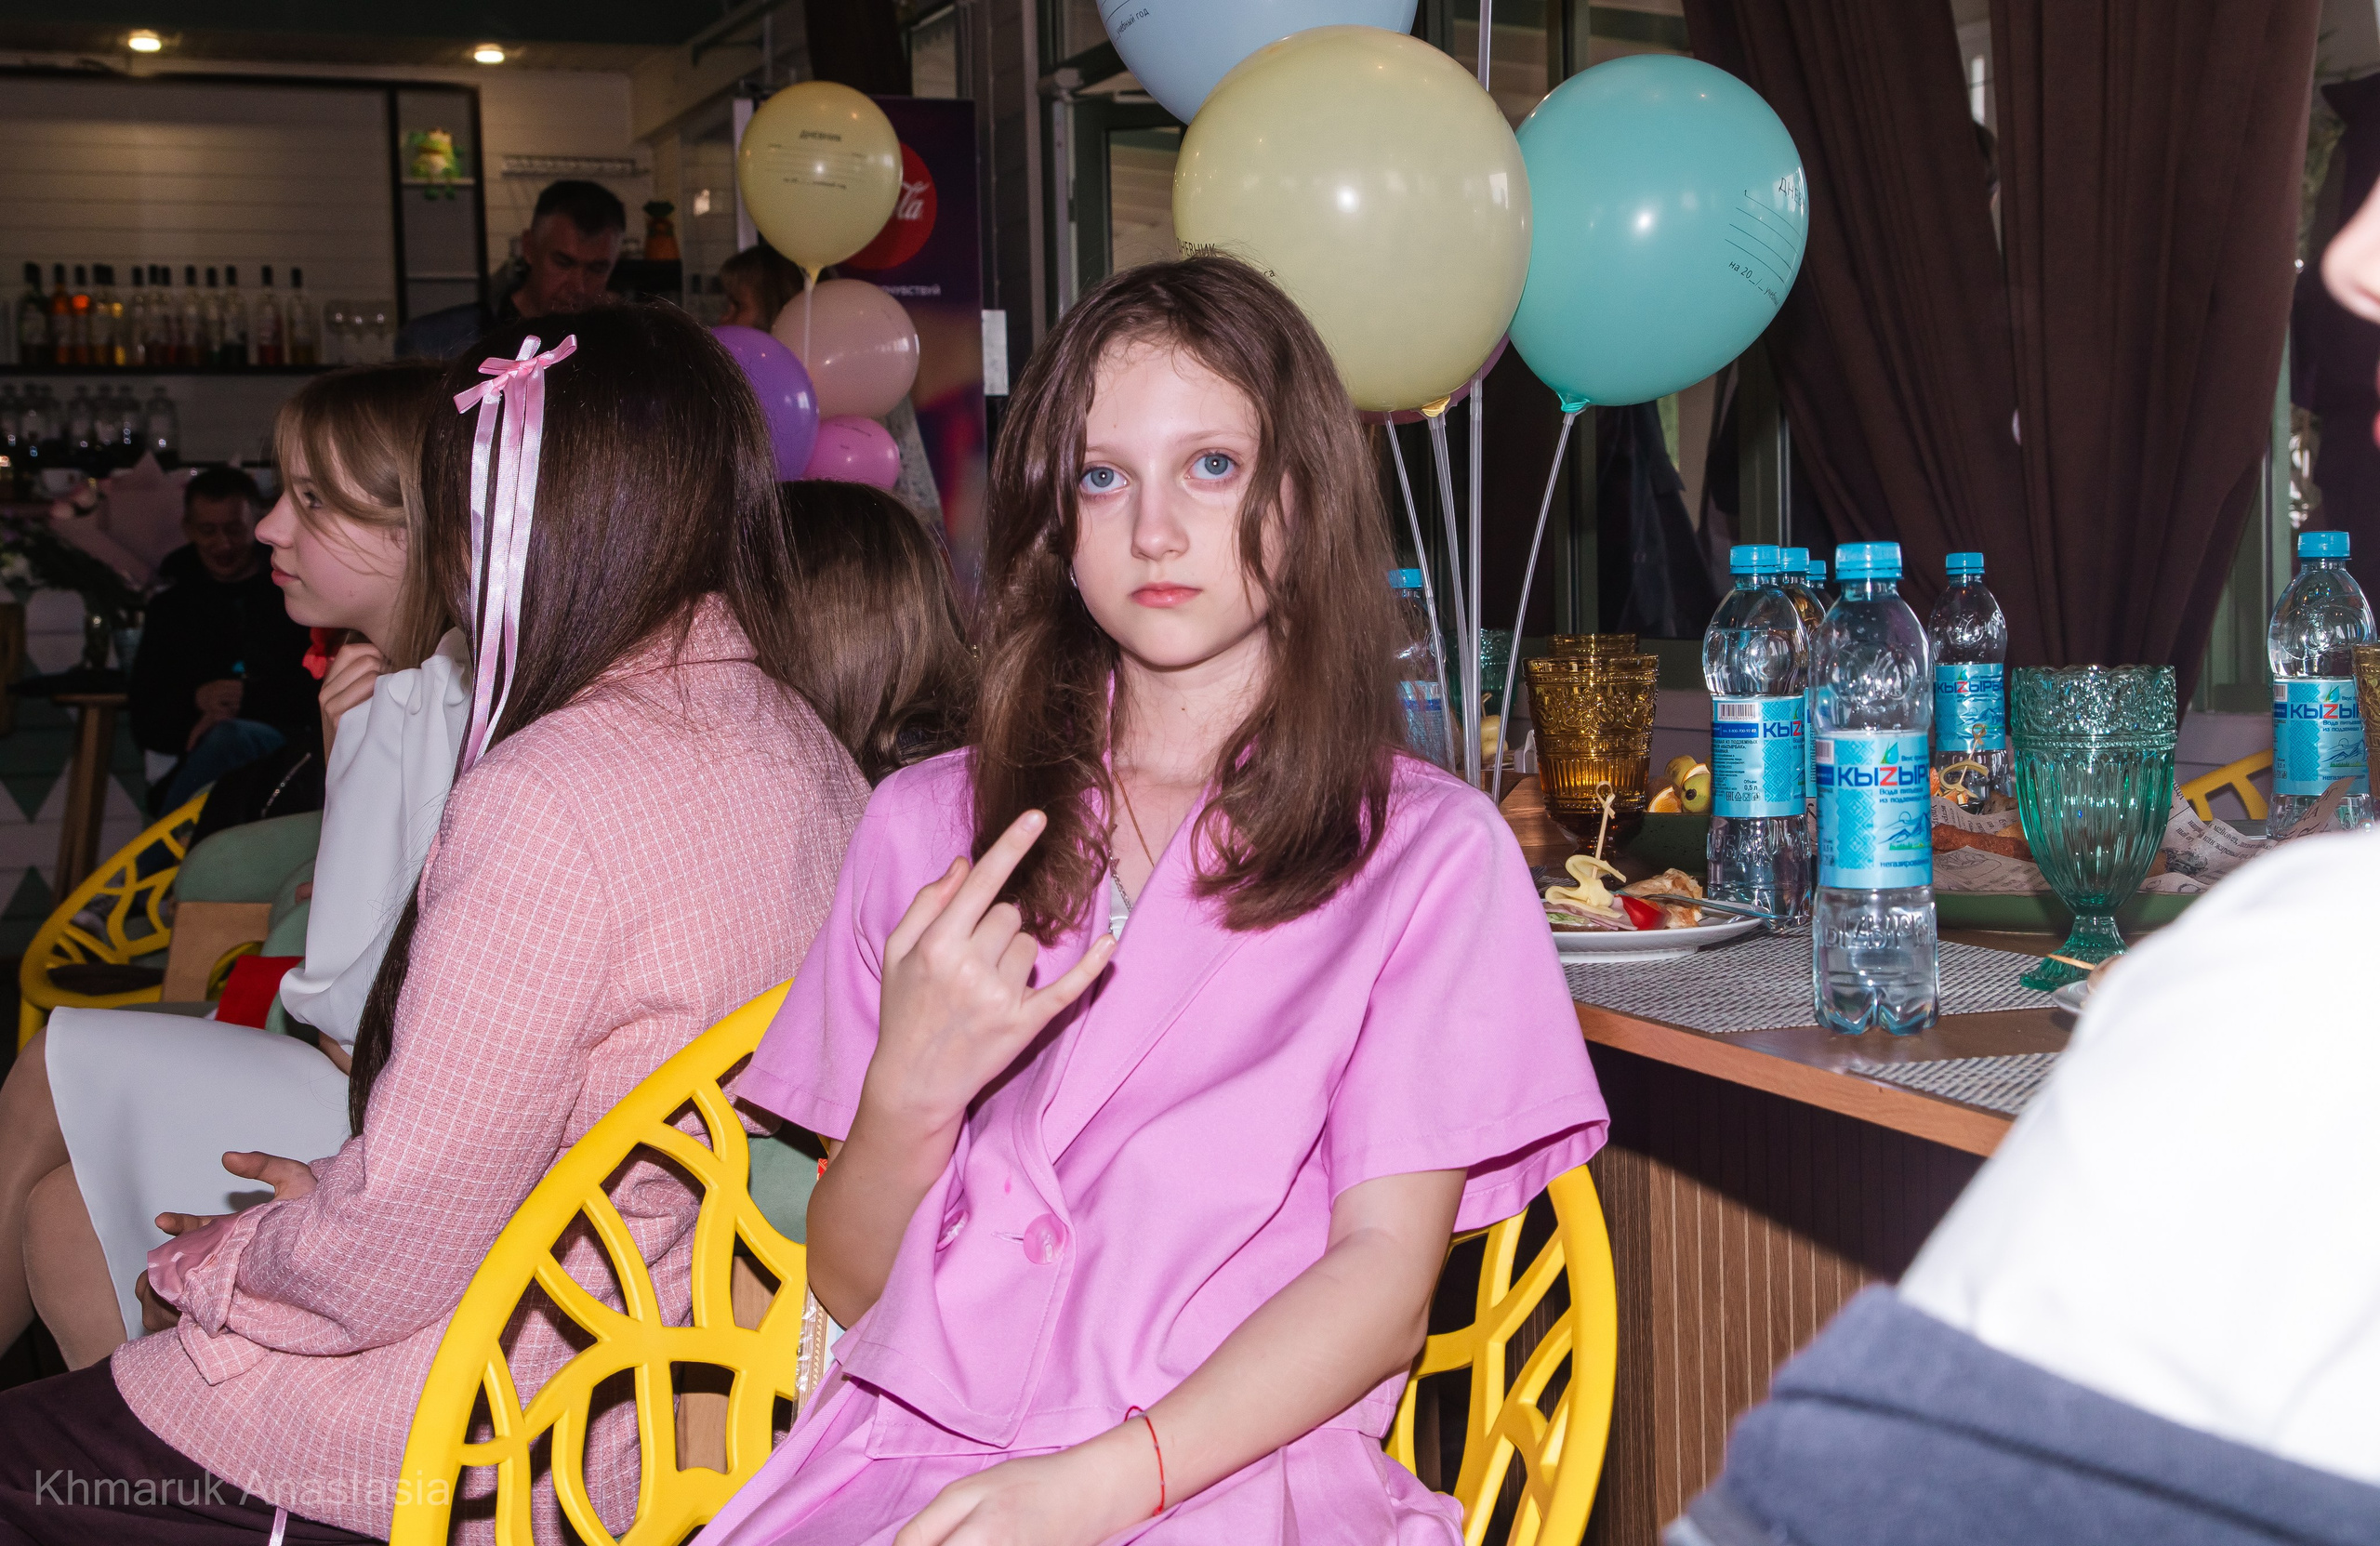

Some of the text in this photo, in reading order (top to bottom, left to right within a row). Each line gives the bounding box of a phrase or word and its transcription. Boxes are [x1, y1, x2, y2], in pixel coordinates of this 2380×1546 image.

[1136, 8, 1150, 20] год
[1728, 261, 1740, 271] на
[1763, 720, 1805, 738] КЫZ
